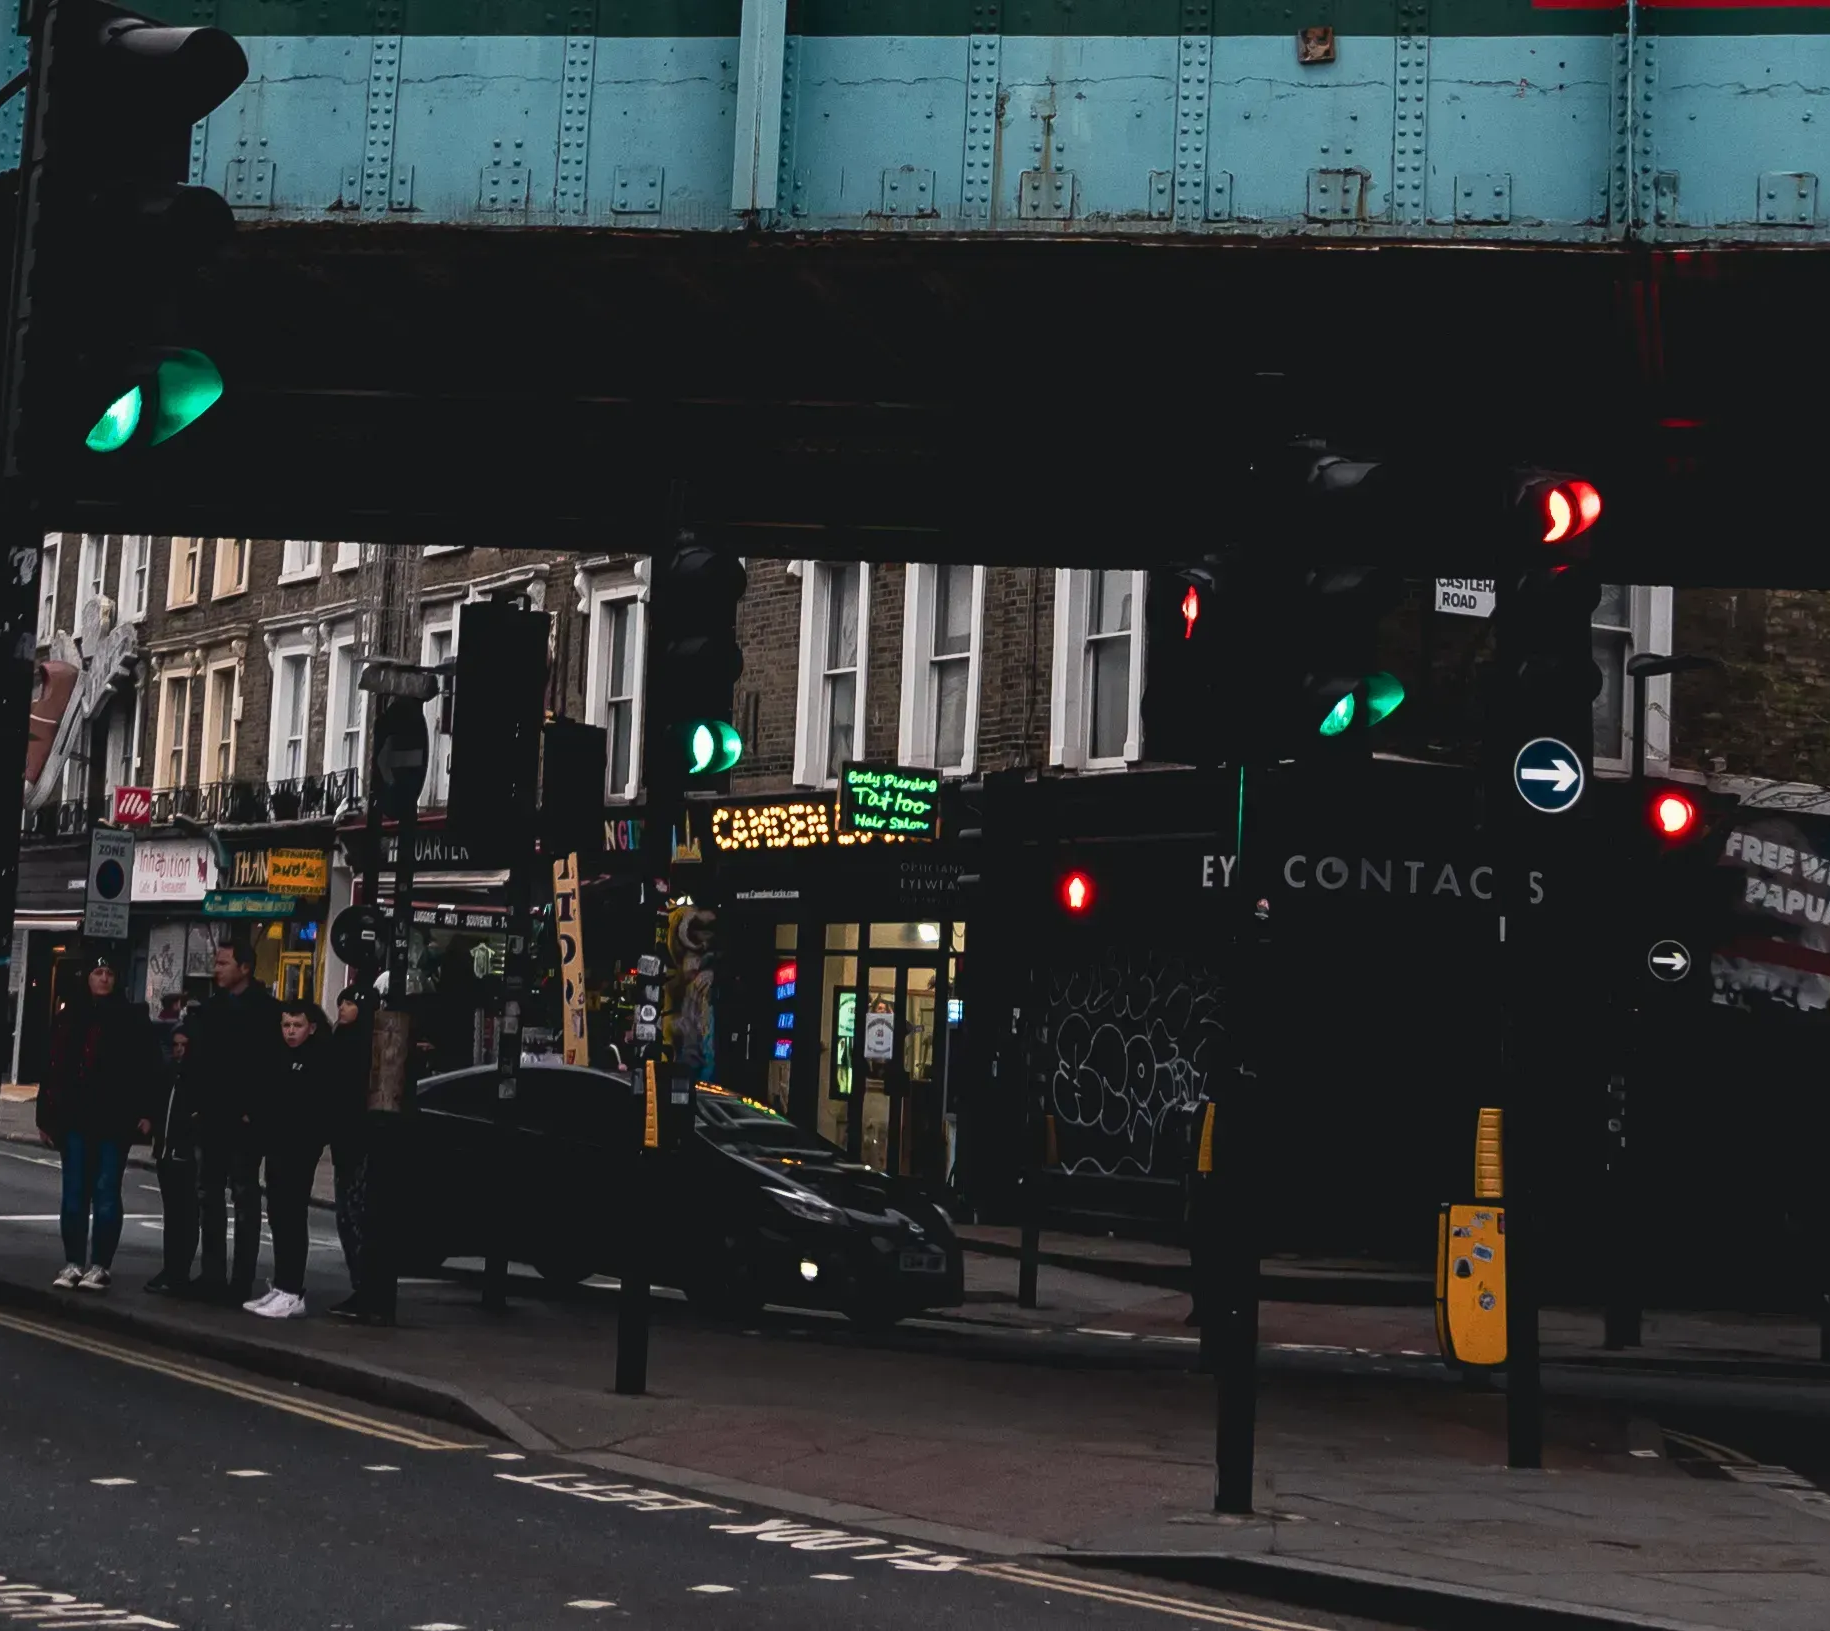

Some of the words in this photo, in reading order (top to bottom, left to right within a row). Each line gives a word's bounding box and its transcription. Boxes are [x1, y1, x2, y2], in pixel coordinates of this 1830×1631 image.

[1442, 591, 1477, 610] ROAD
[848, 768, 881, 790] Body
[118, 792, 149, 819] illy
[711, 803, 830, 851] CAMDEN
[853, 812, 887, 830] Hair
[888, 816, 930, 832] Salon
[98, 845, 126, 857] ZONE
[1725, 830, 1800, 875] FREE
[1283, 854, 1545, 905] CONTACS
